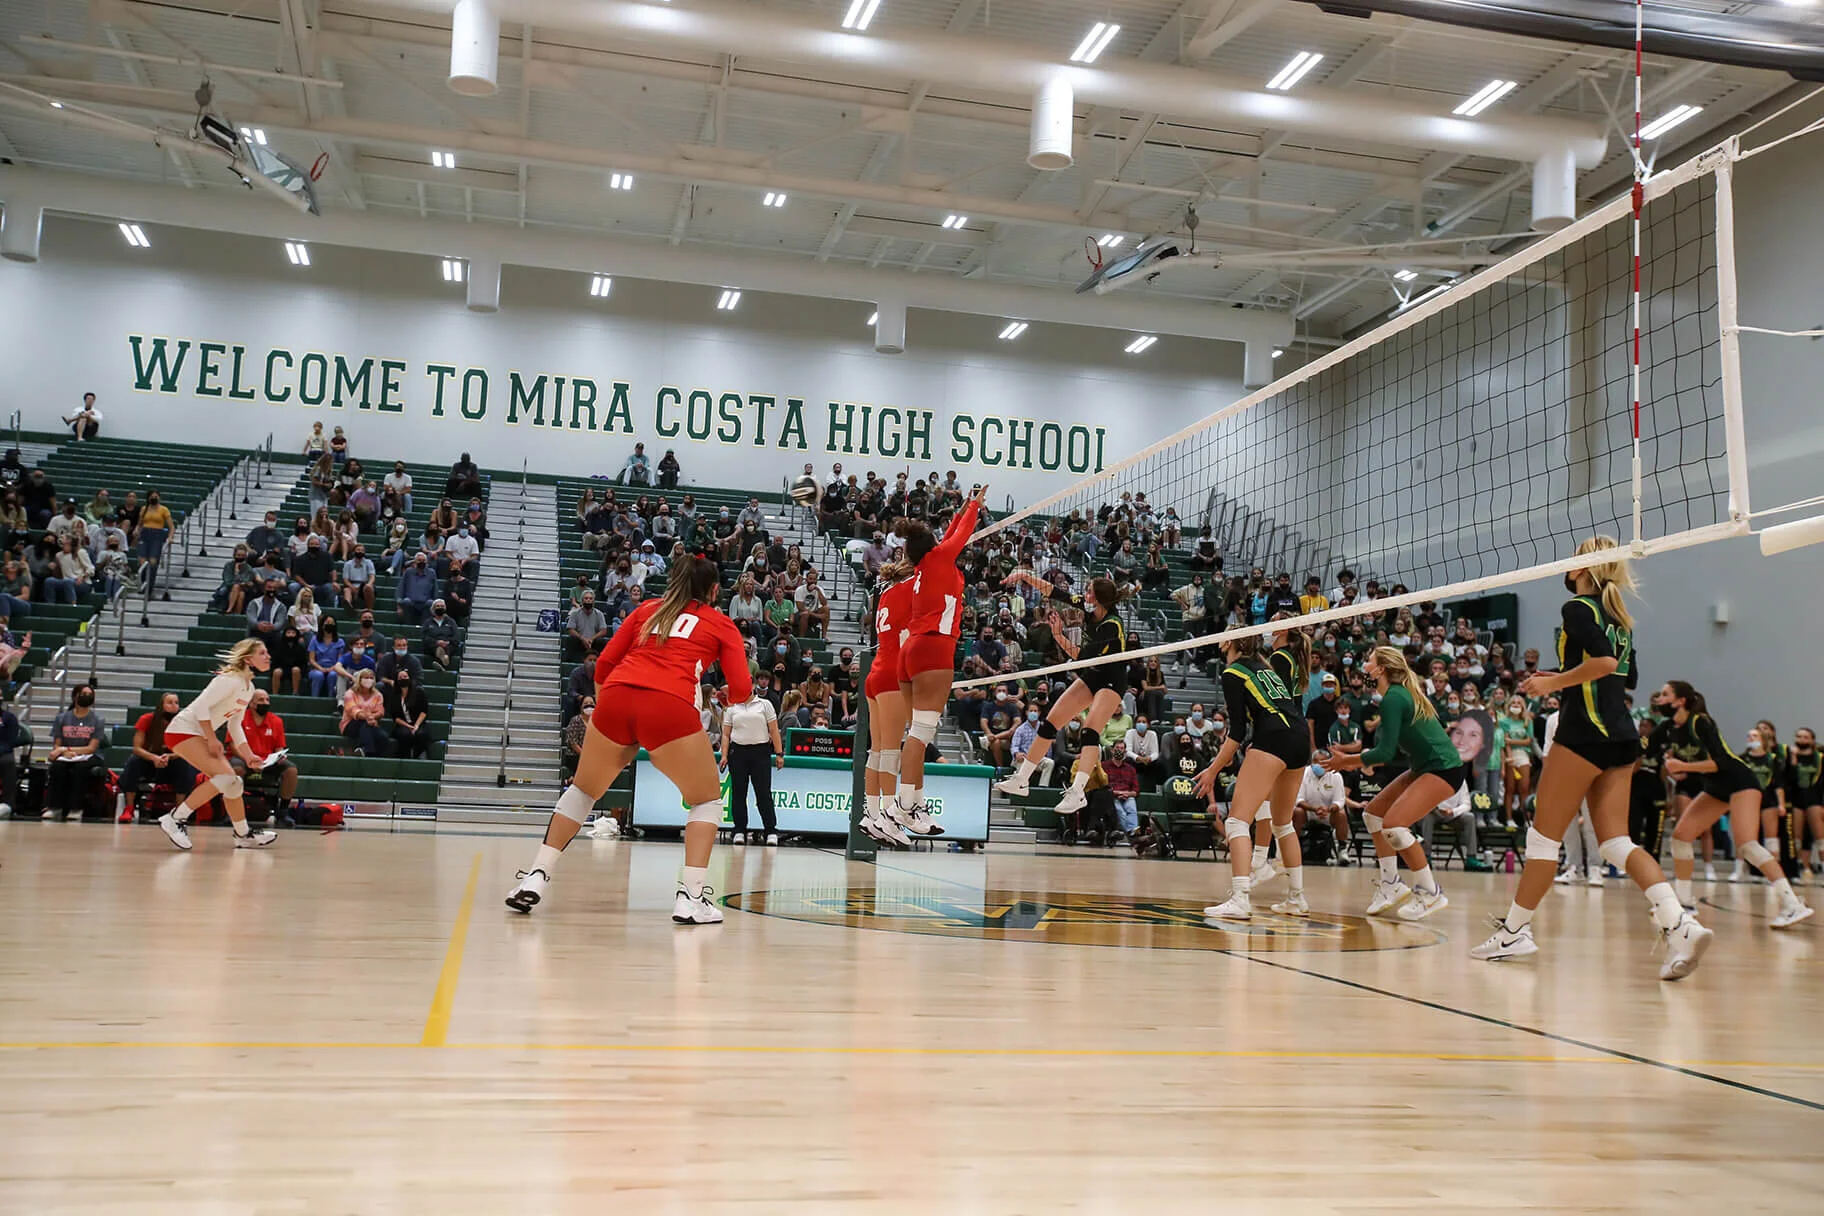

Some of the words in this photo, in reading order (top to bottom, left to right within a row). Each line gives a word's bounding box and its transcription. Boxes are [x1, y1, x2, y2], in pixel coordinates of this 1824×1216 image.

[128, 335, 407, 413] WELCOME
[426, 364, 490, 420] TO
[506, 372, 635, 434] MIRA
[655, 387, 808, 450] COSTA
[826, 402, 934, 460] HIGH
[651, 613, 700, 639] 0
